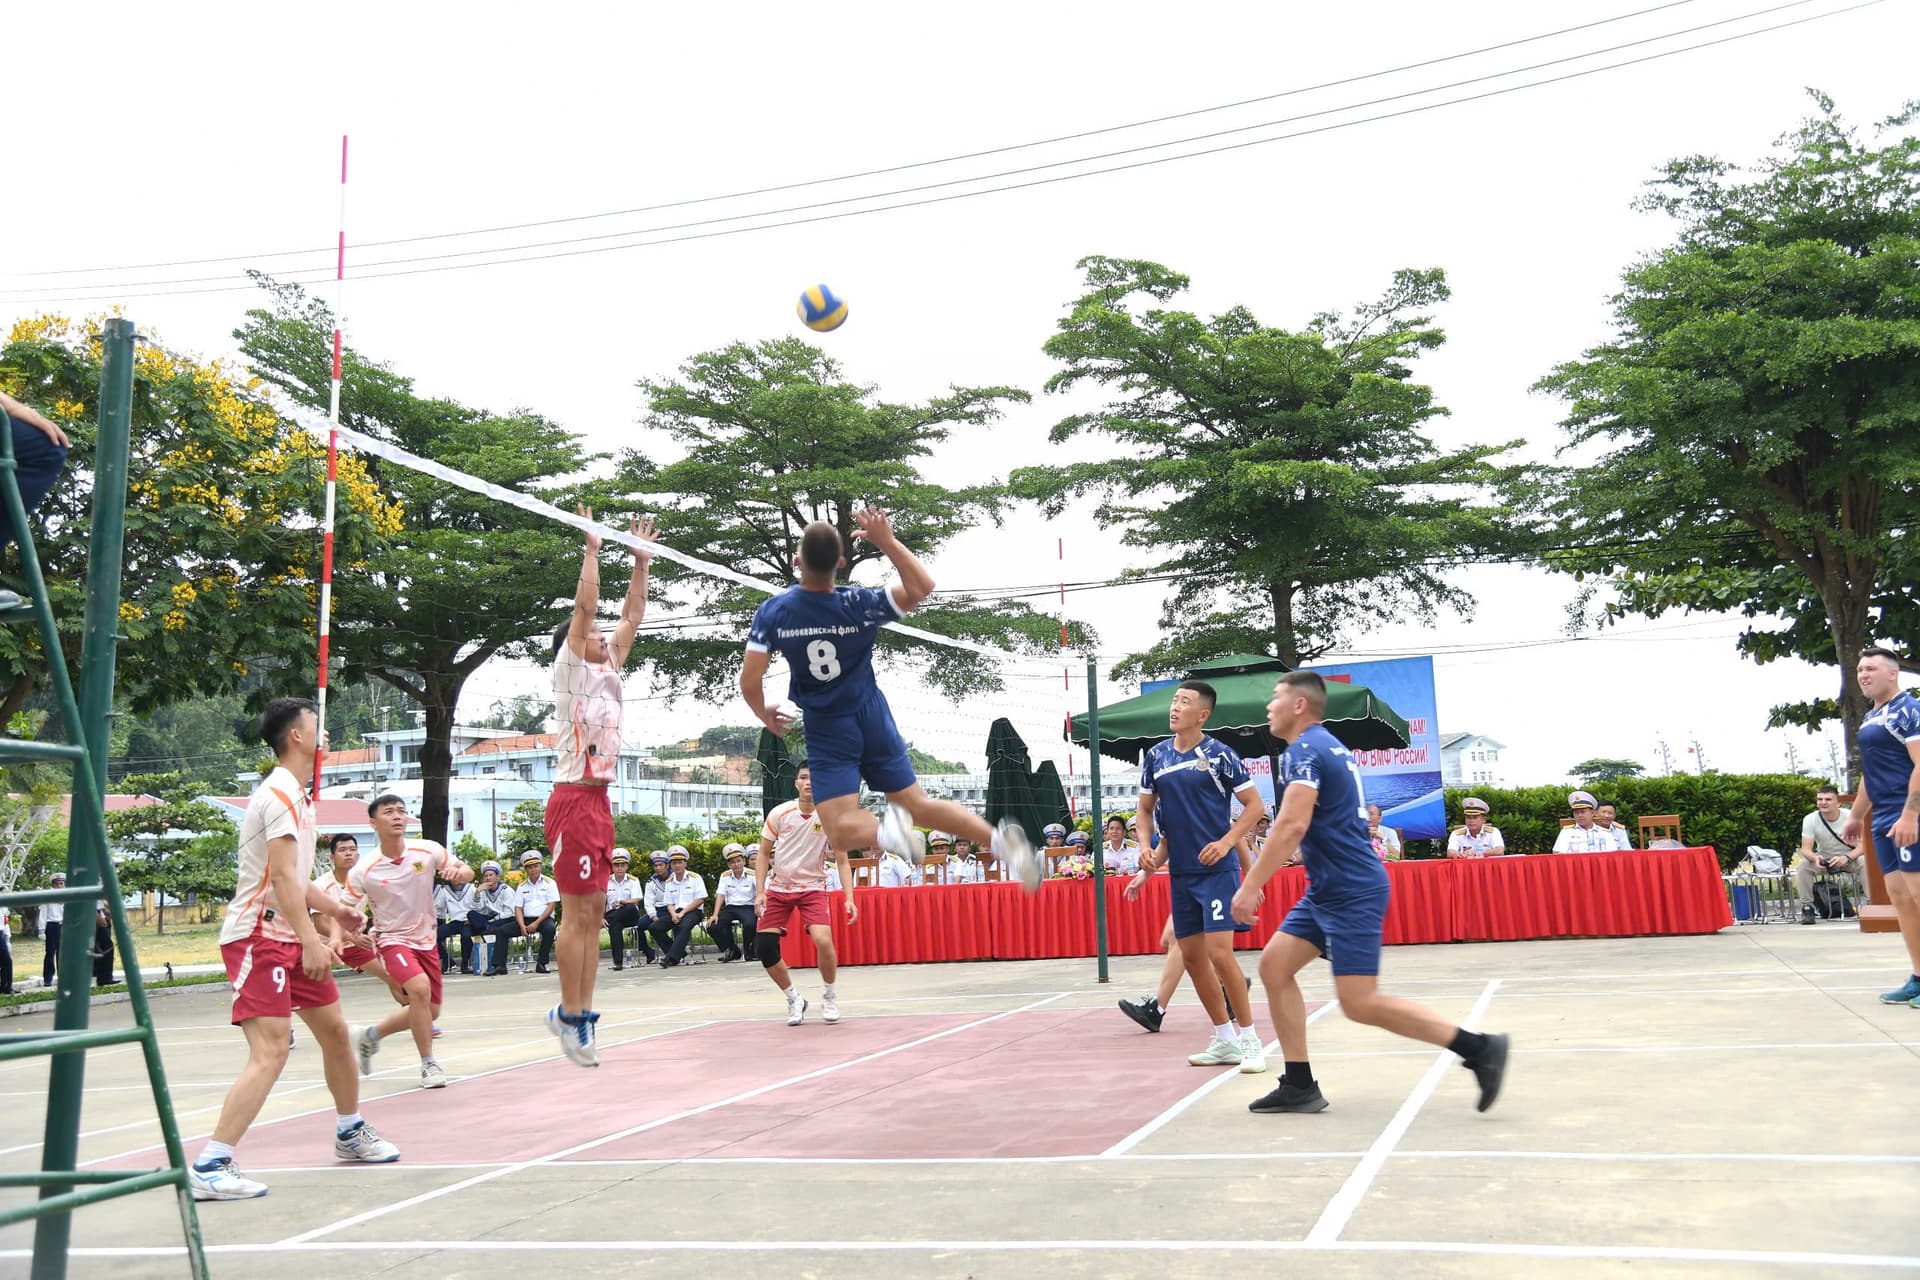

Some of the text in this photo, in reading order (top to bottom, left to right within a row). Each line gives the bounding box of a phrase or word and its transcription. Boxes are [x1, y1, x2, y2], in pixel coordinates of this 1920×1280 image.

[806, 639, 841, 682] 8
[579, 854, 591, 880] 3
[1211, 898, 1224, 920] 2
[395, 952, 407, 967] 1
[272, 966, 286, 993] 9
